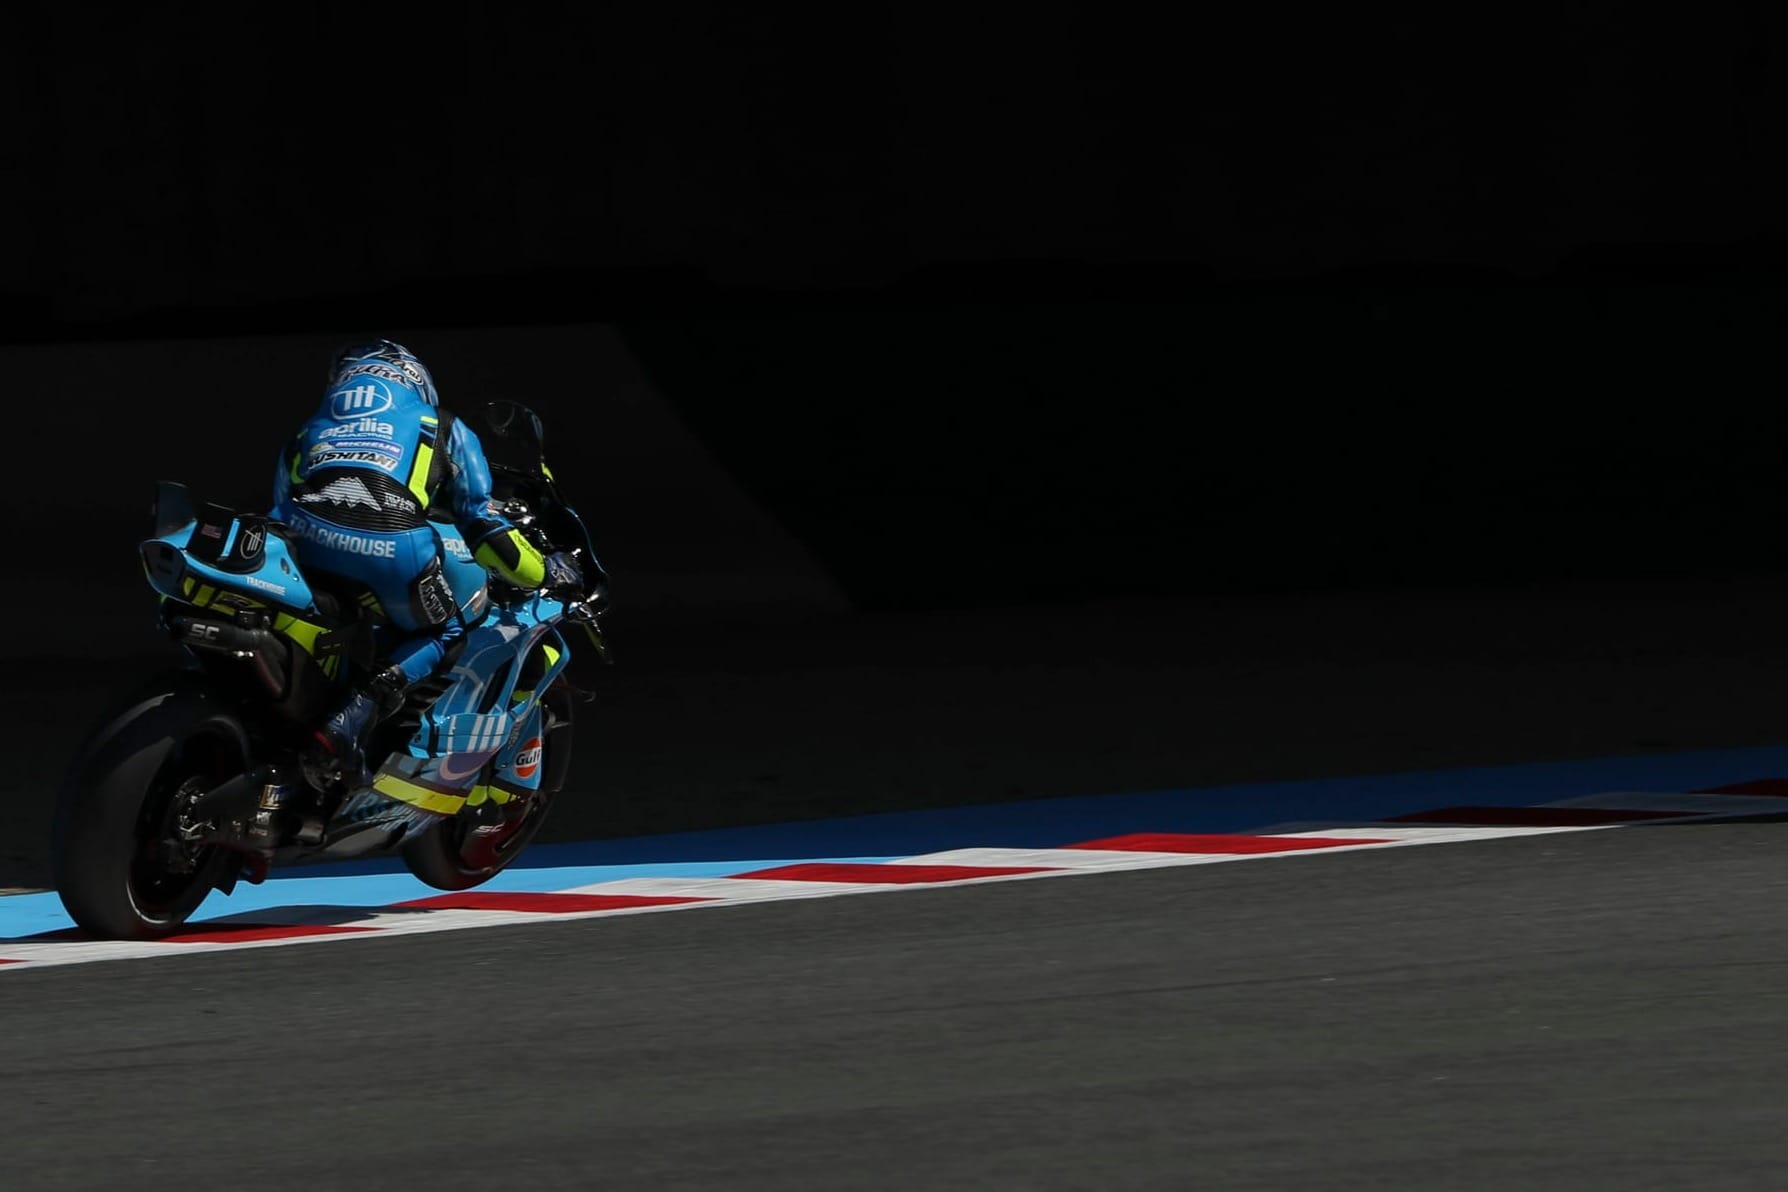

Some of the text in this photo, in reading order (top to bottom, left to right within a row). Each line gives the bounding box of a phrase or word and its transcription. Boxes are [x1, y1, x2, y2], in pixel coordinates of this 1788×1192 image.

[318, 418, 394, 439] aprilia
[335, 441, 401, 453] MICHELIN
[289, 513, 396, 559] TRACKHOUSE
[190, 623, 220, 640] SC
